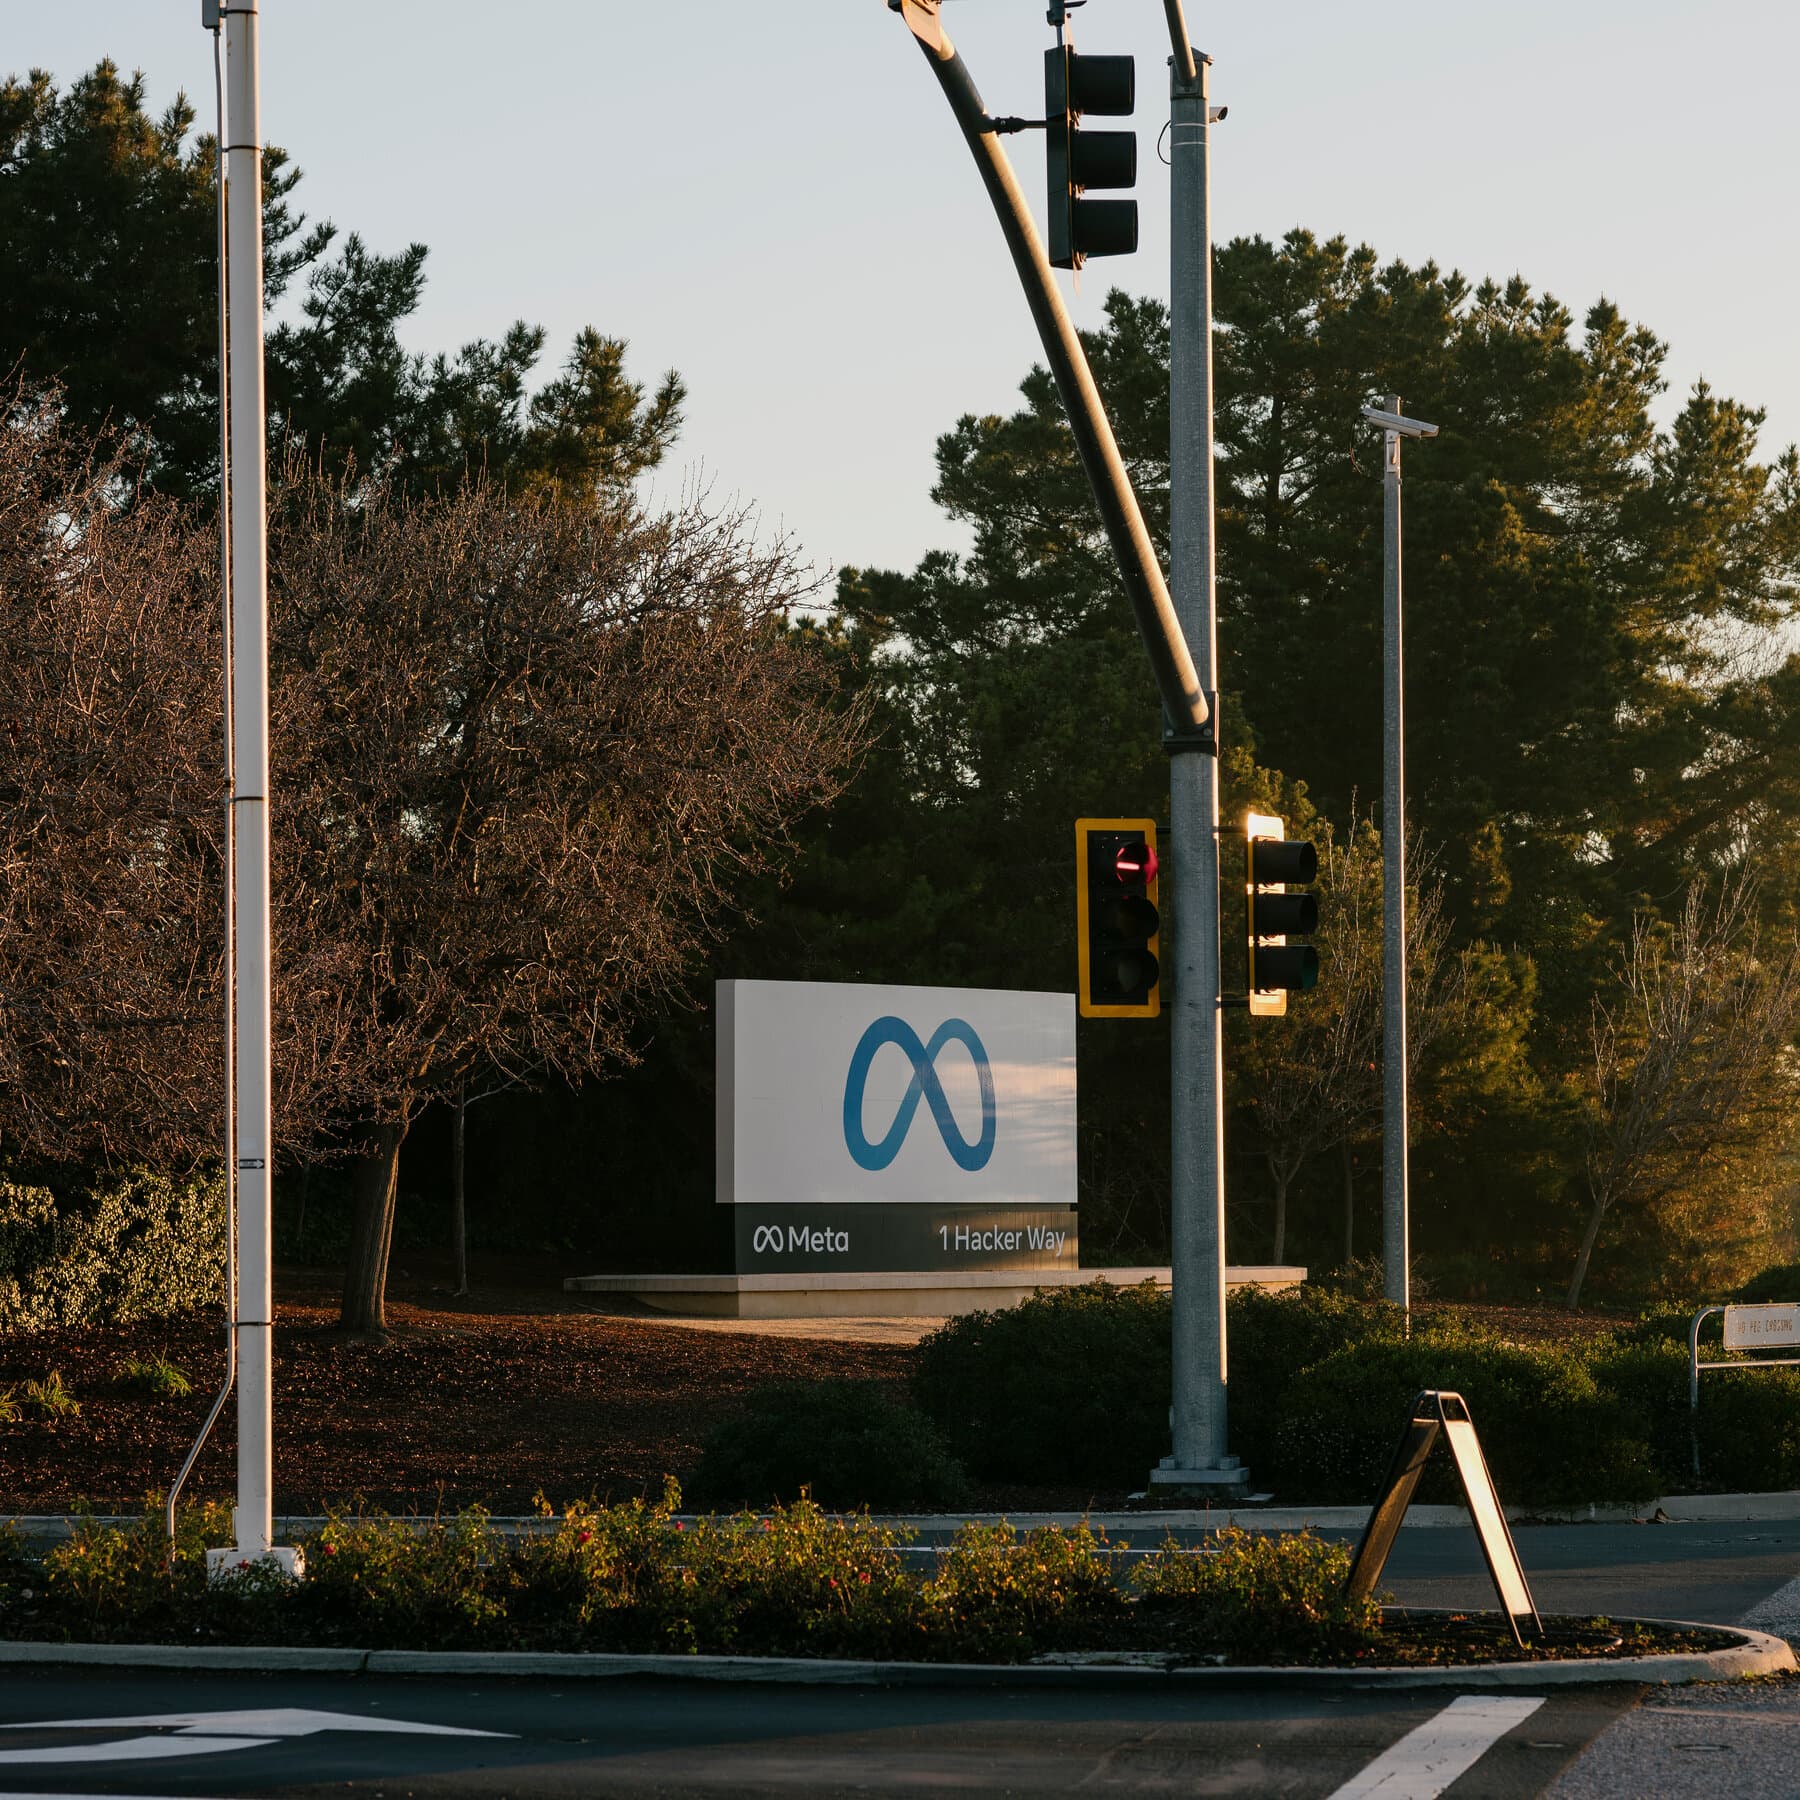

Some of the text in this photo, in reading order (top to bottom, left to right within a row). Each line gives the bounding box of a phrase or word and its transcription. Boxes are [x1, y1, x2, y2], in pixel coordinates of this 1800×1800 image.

[788, 1226, 849, 1252] Meta
[939, 1224, 1066, 1257] 1 Hacker Way
